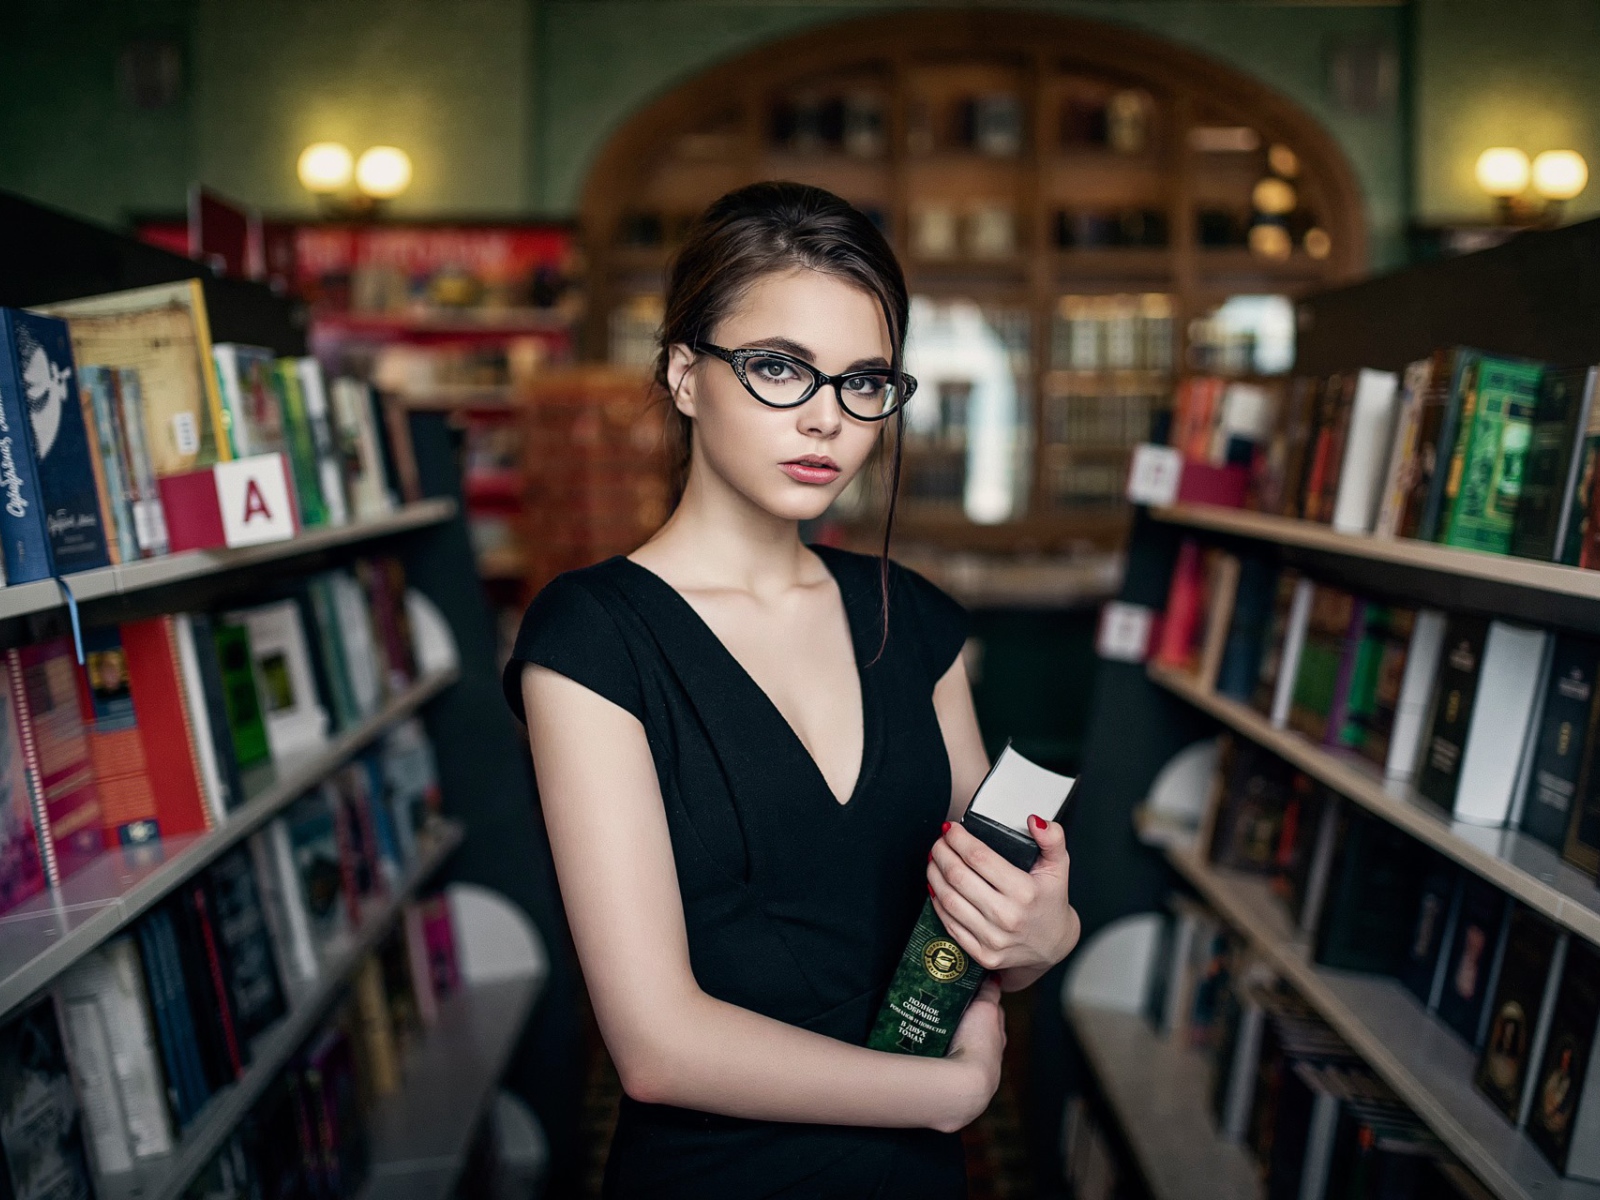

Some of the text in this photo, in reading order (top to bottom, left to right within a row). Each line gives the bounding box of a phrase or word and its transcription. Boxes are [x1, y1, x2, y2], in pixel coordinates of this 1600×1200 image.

[244, 479, 271, 522] А
[902, 1001, 941, 1024] СОБРАНИЕ
[908, 996, 940, 1016] ПОЛНОЕ
[889, 1003, 914, 1021] РОМАНОВ
[918, 1020, 947, 1035] ПОВЕСТЕЙ
[898, 1027, 925, 1044] ТОМАХ
[906, 1023, 927, 1038] ДВУХ
